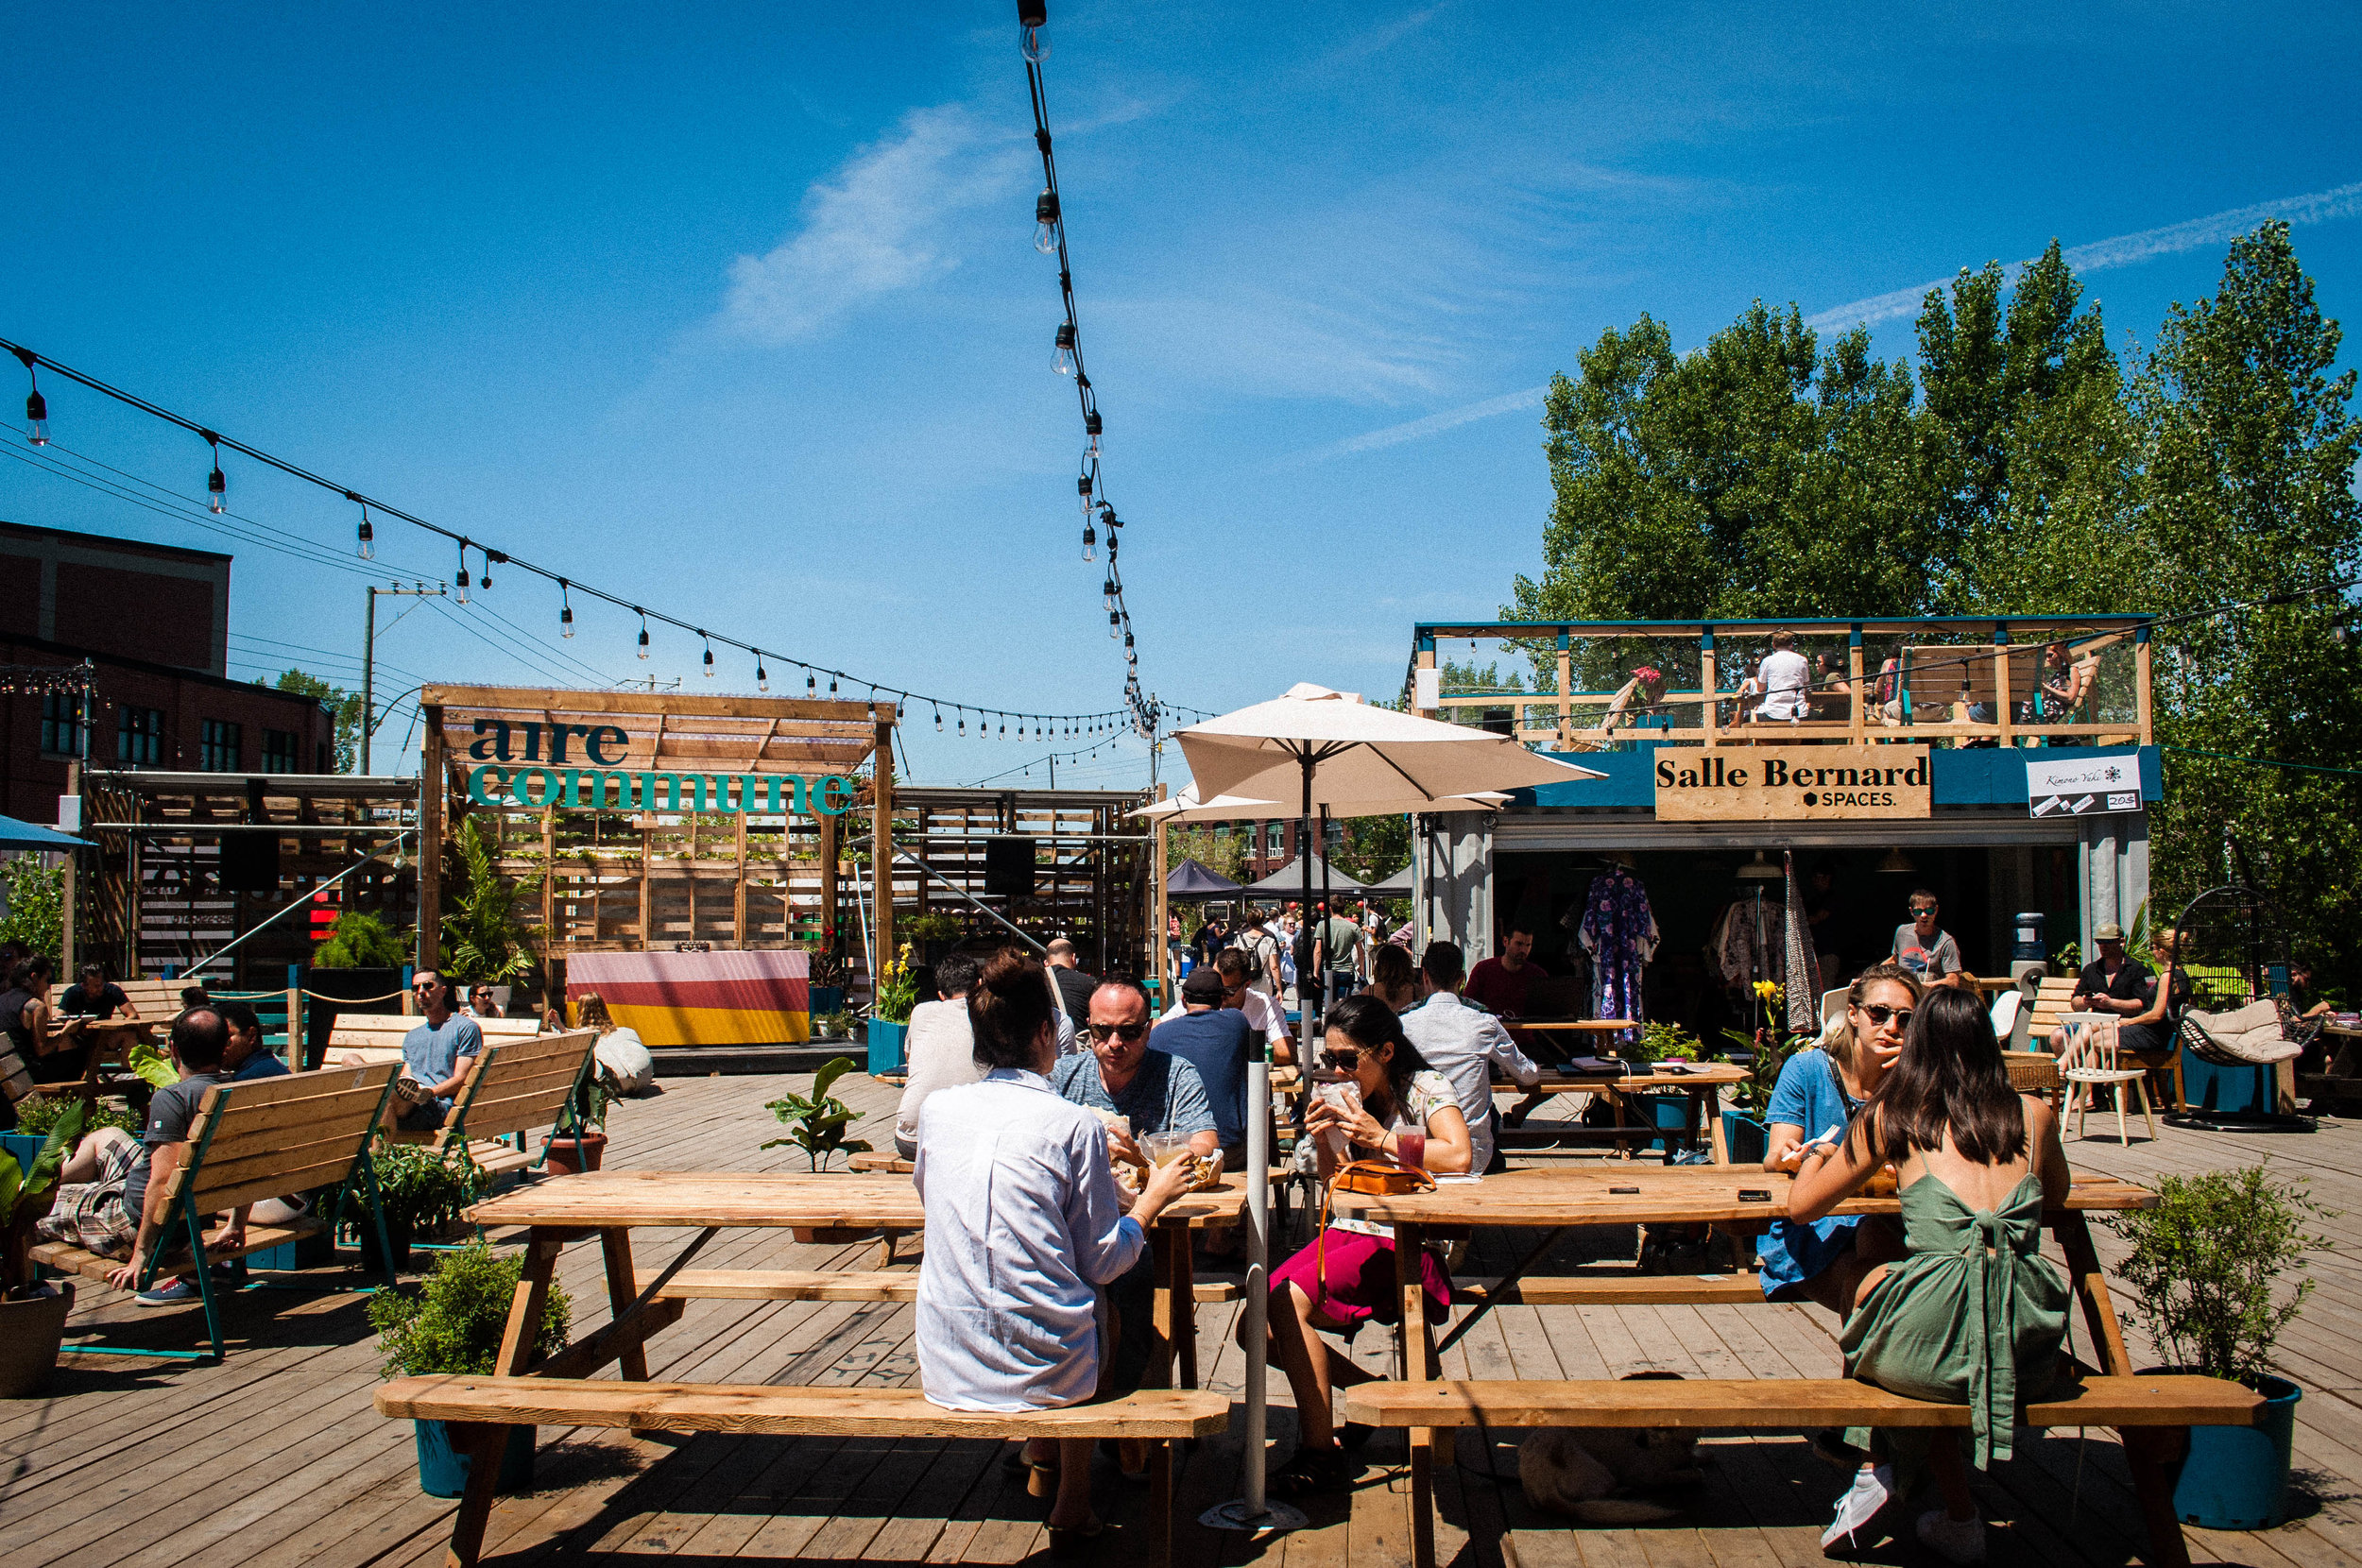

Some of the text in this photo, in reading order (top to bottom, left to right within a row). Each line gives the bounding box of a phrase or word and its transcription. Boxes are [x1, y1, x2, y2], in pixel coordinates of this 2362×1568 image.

[469, 719, 630, 766] aire
[1656, 756, 1929, 788] Salle Bernard
[2045, 775, 2079, 787] Kimono
[469, 765, 853, 816] commune
[1822, 792, 1896, 807] SPACES.
[2108, 794, 2135, 808] 20$
